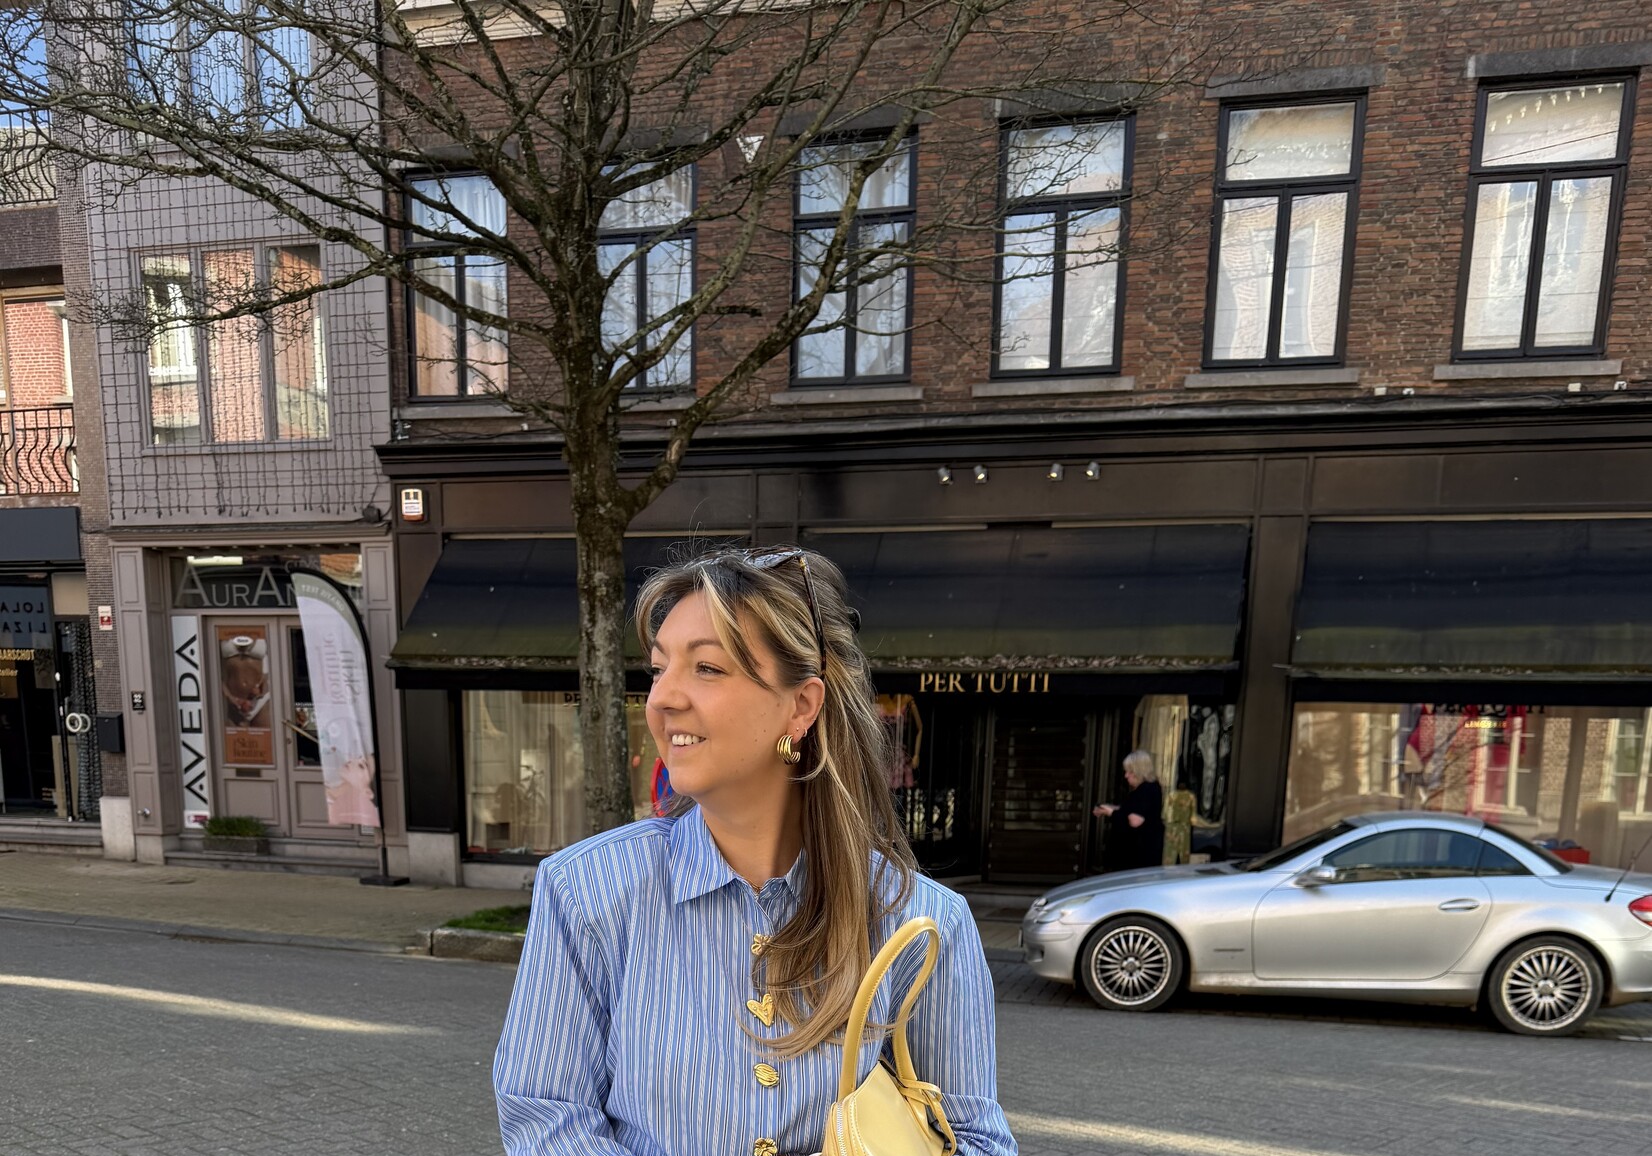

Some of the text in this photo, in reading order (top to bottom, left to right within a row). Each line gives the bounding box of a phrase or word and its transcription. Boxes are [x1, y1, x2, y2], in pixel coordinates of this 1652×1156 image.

[175, 634, 209, 805] AVEDA
[919, 672, 1050, 693] PER TUTTI
